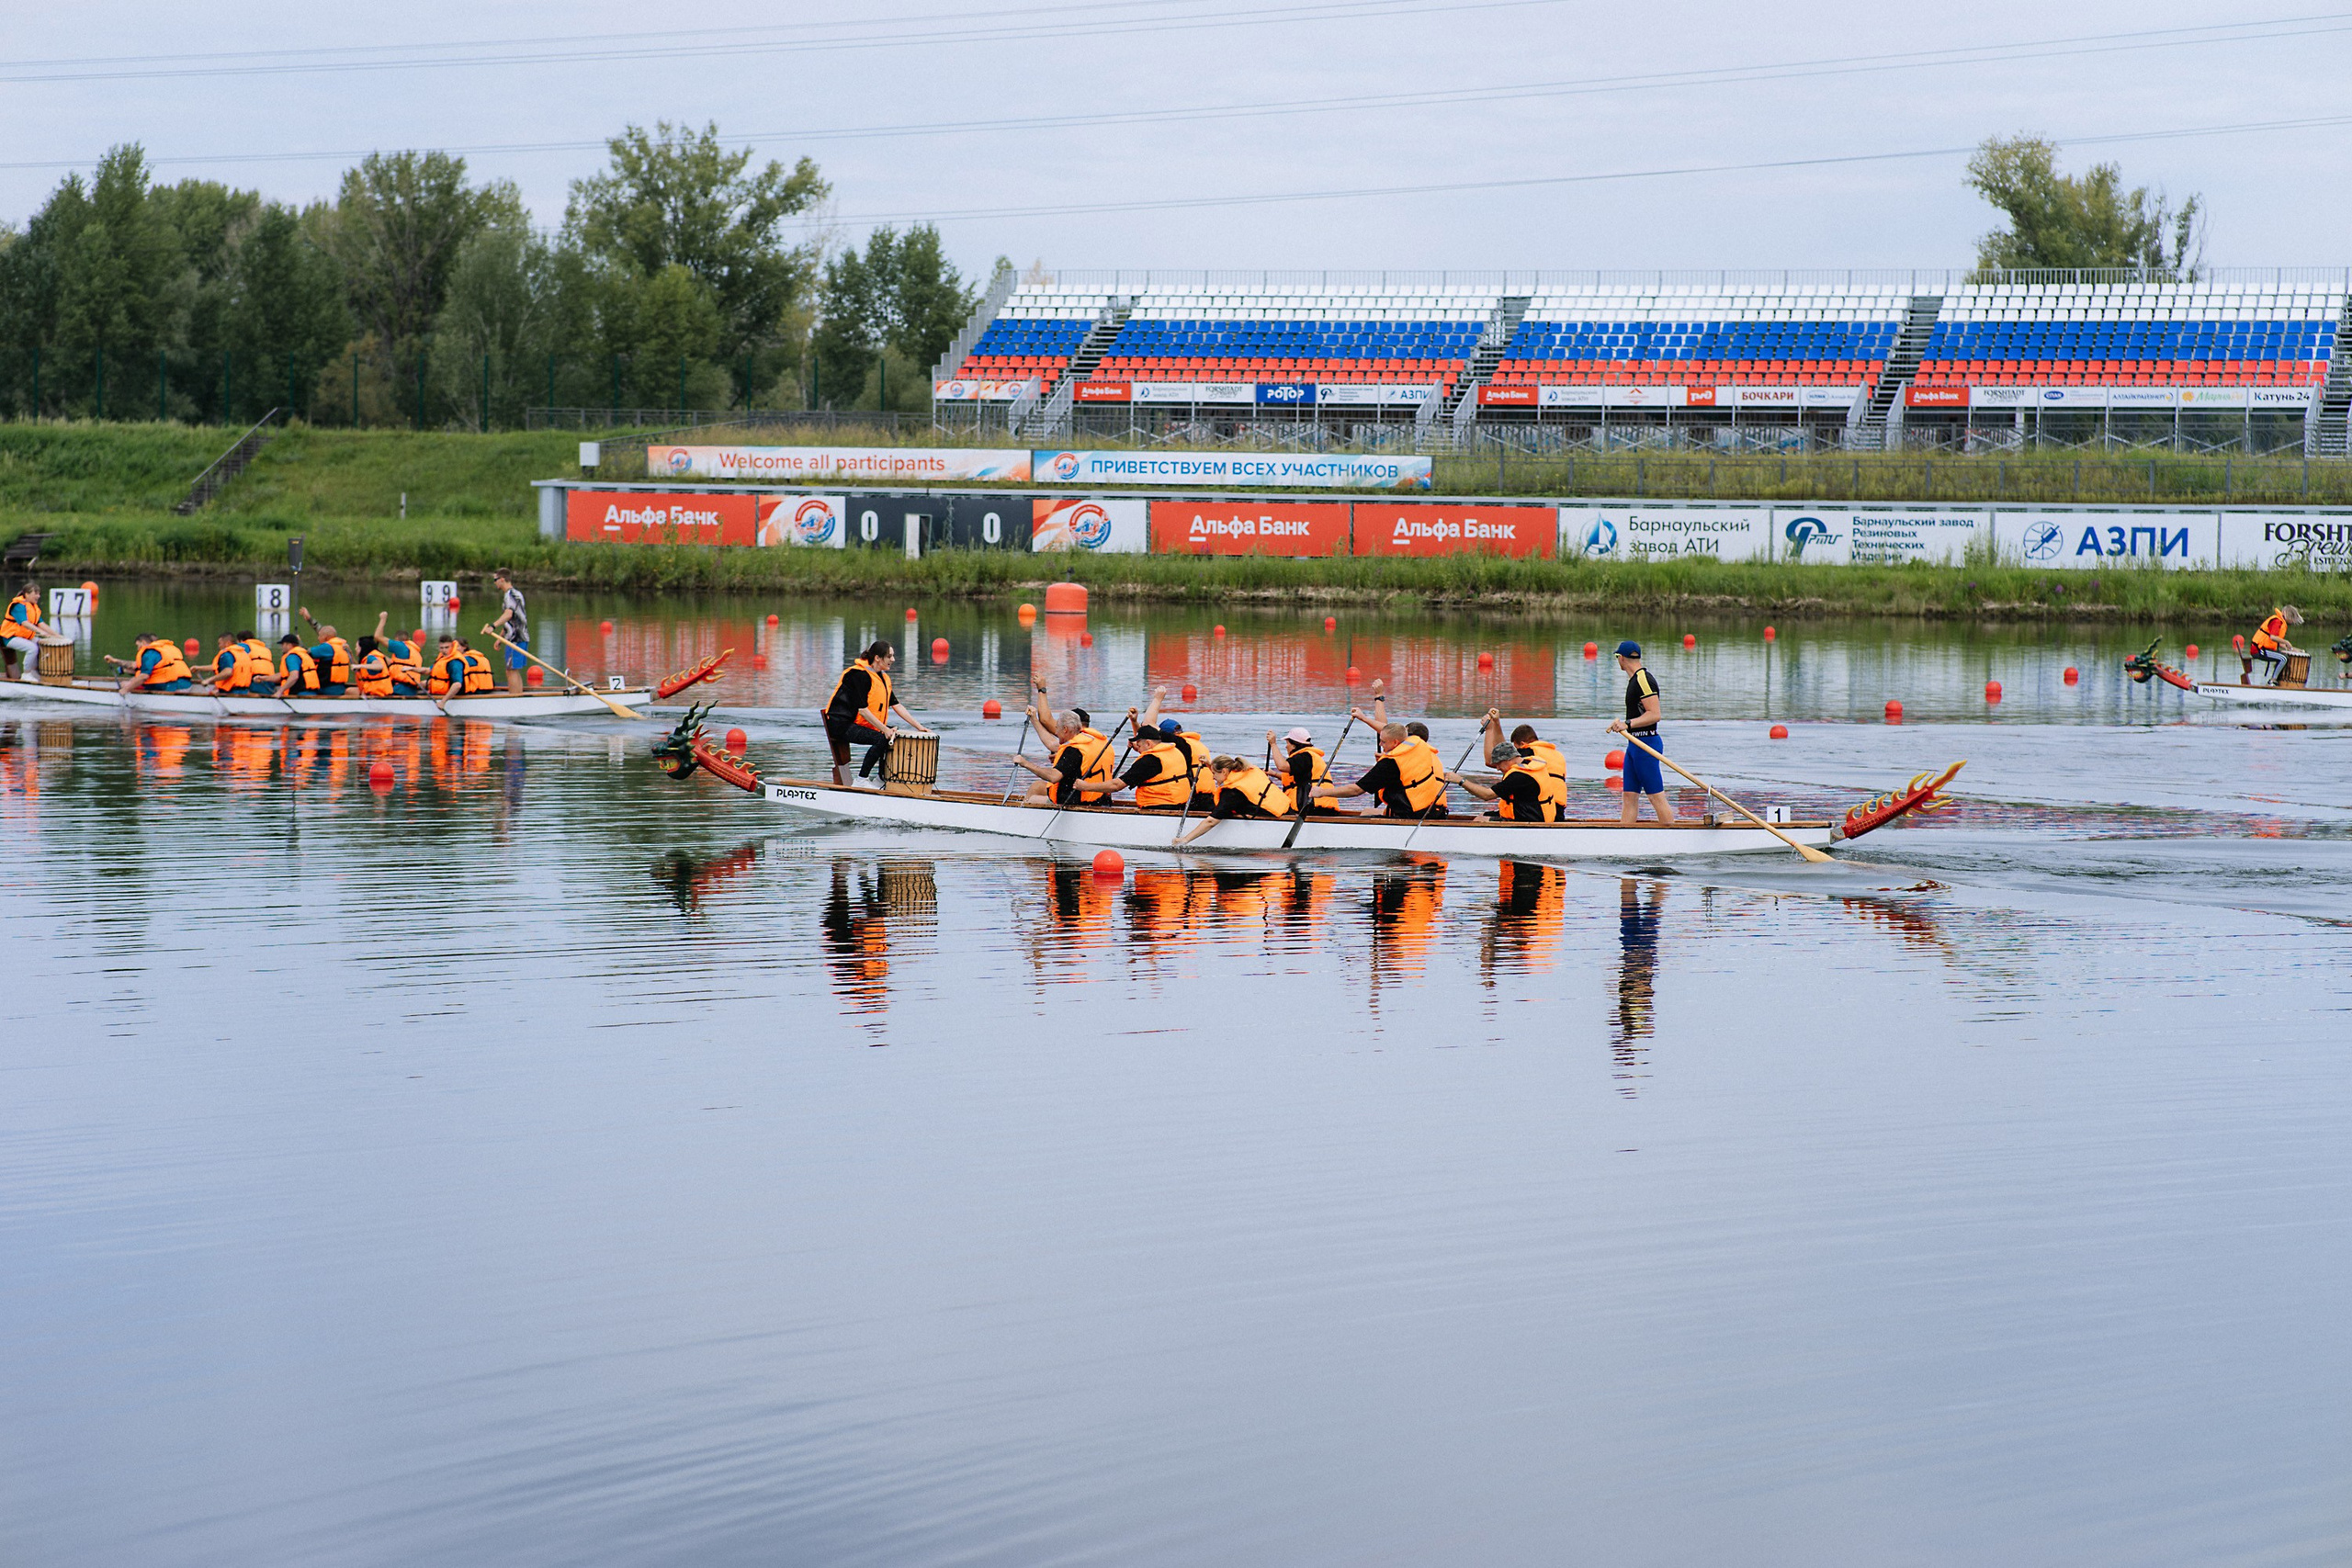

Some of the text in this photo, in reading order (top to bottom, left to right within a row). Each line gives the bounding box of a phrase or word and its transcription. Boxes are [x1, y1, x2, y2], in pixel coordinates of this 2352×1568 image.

[1081, 387, 1122, 397] Альфа Банк
[1486, 390, 1529, 401] Альфа Банк
[1742, 391, 1793, 400] БОЧКАРИ
[1913, 391, 1960, 402] Альфа Банк
[2254, 391, 2310, 402] Катунь 24
[719, 453, 944, 475] Welcome all participants
[1091, 460, 1227, 475] ПРИВЕТСТВУЕМ
[1232, 462, 1276, 476] ВСЕХ
[1282, 463, 1398, 478] УЧАСТНИКОВ
[604, 504, 718, 531] Альфа Банк
[1852, 516, 1973, 528] Барнаульский завод
[1189, 514, 1310, 541] Альфа Банк
[1392, 517, 1516, 545] Альфа Банк
[1629, 515, 1750, 536] Барнаульский
[1852, 528, 1917, 538] Резиновых
[1629, 537, 1719, 554] завод АТИ
[1852, 539, 1925, 549] Технических
[2075, 526, 2188, 557] АЗПИ
[612, 678, 621, 690] 2
[1774, 807, 1781, 823] 1
